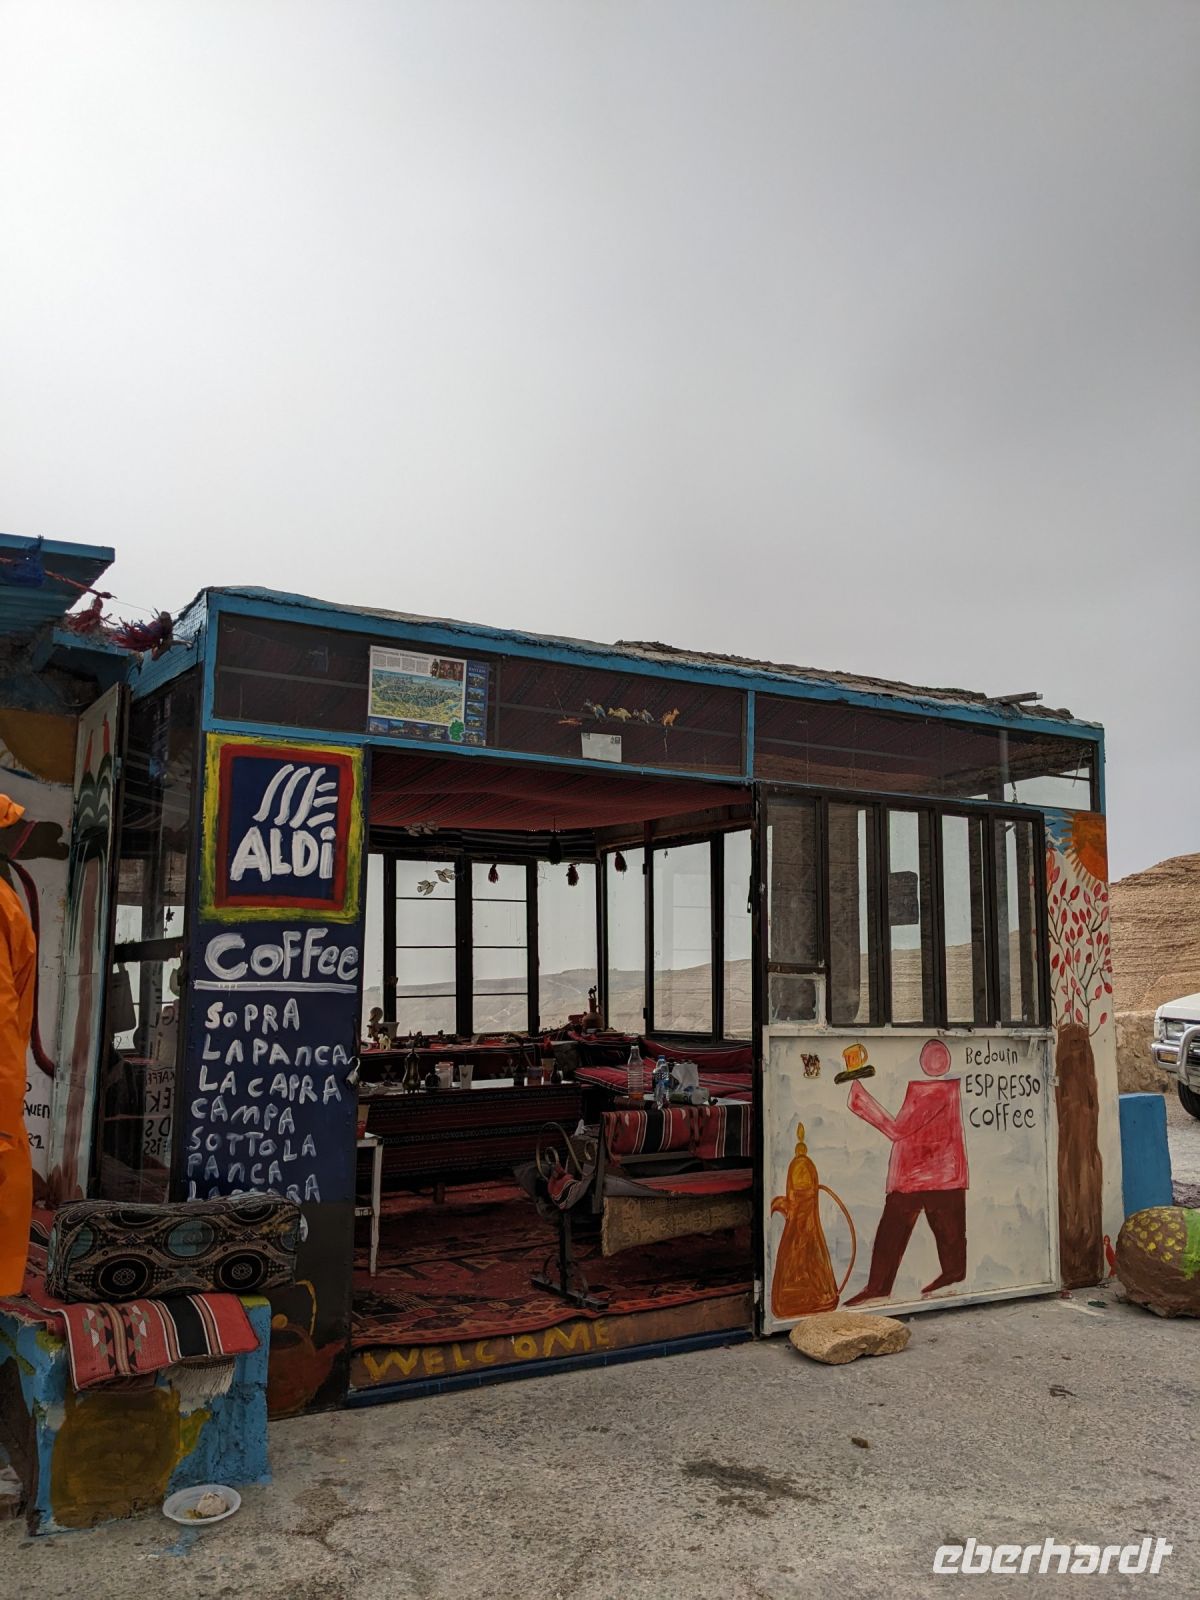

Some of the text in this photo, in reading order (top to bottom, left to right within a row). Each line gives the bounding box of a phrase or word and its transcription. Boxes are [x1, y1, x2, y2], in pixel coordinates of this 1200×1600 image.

[965, 1039, 1019, 1066] Bedouin
[965, 1073, 1042, 1101] ESPRESSO
[362, 1320, 610, 1382] WELCOME
